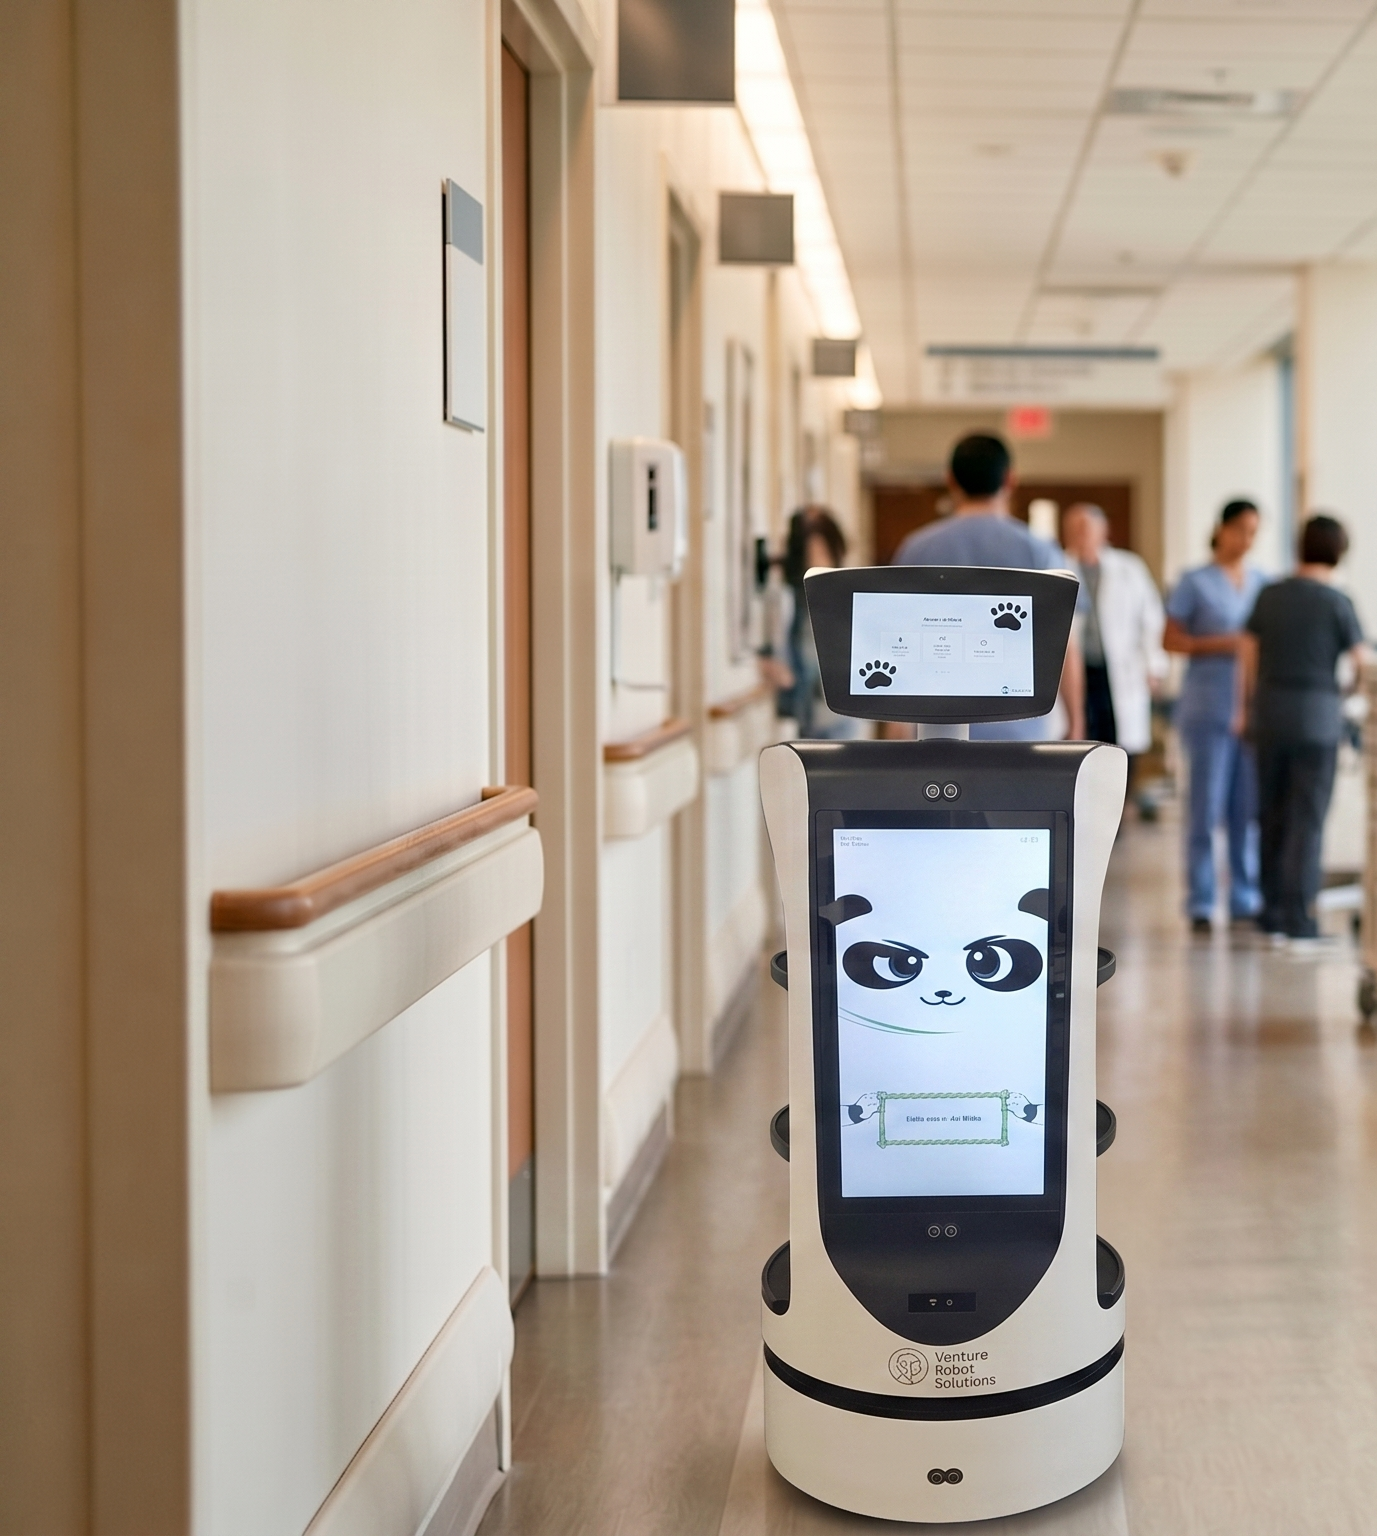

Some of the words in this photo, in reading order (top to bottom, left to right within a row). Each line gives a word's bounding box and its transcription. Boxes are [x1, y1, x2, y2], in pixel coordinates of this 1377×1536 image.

[935, 1351, 988, 1362] Venture
[935, 1363, 975, 1376] Robot
[935, 1376, 996, 1389] Solutions
